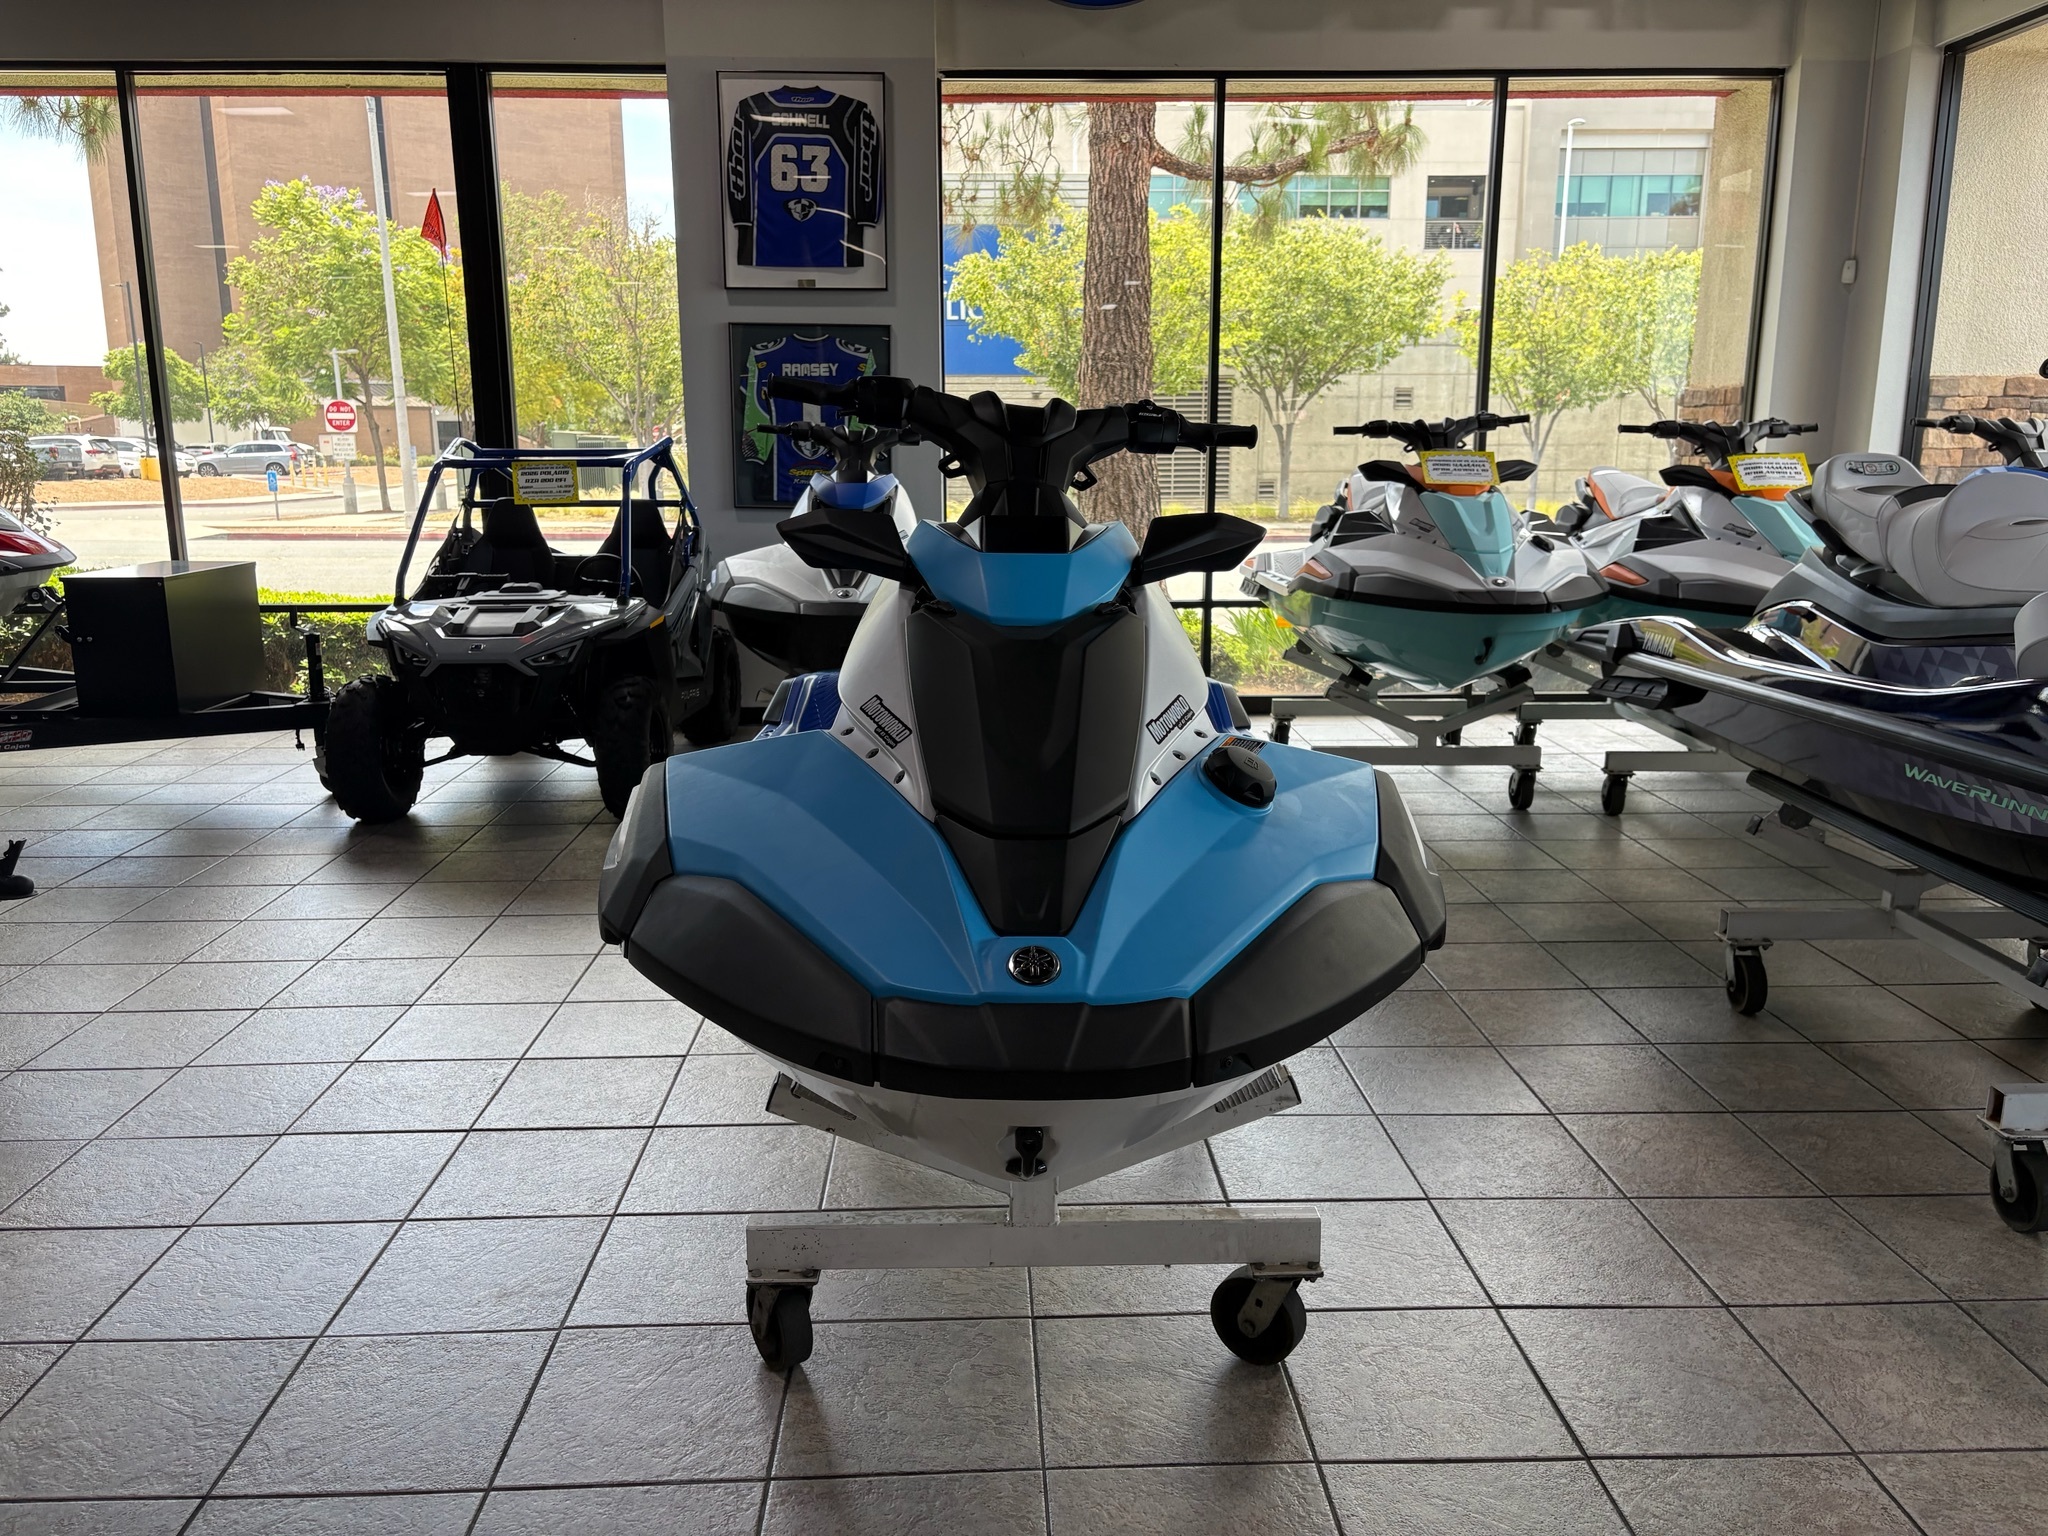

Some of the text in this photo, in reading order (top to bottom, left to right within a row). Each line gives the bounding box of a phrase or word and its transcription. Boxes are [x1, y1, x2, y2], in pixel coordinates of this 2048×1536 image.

[771, 112, 831, 129] SCHNELL
[770, 144, 831, 193] 63
[781, 363, 840, 377] RAMSEY
[1642, 631, 1676, 658] YAMAHA
[861, 696, 911, 742] MOTOWORLD
[1148, 695, 1190, 742] MOTOWORLD
